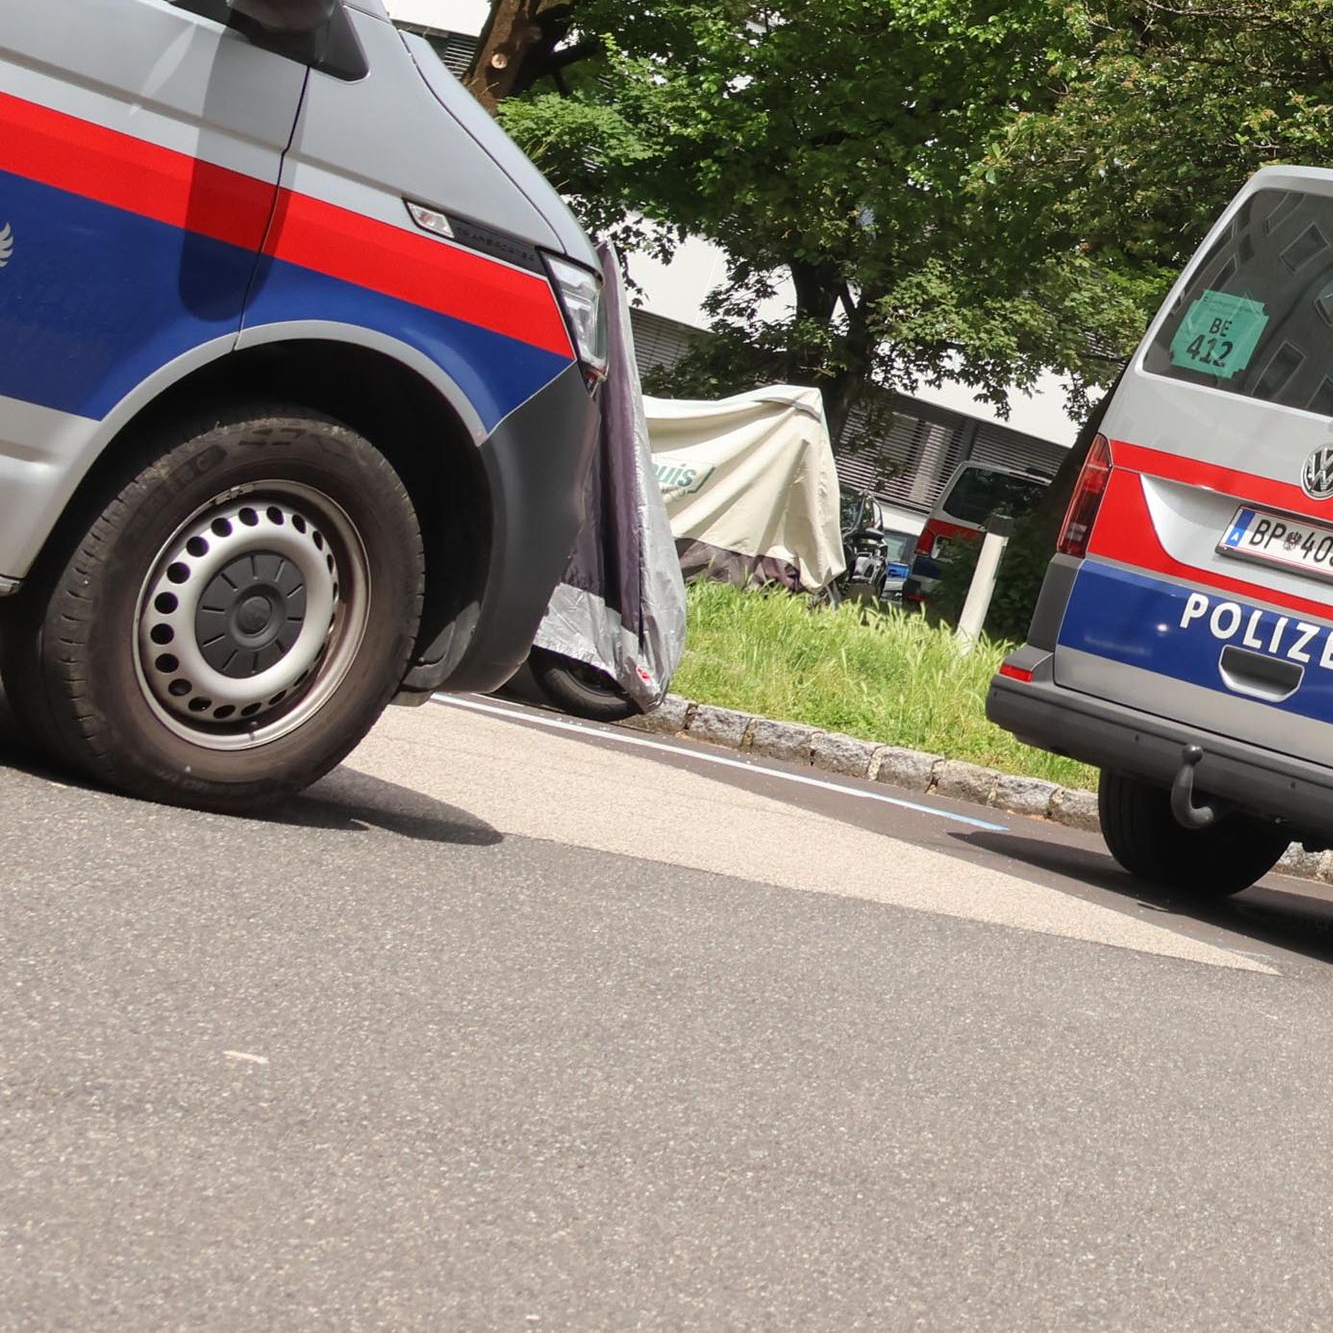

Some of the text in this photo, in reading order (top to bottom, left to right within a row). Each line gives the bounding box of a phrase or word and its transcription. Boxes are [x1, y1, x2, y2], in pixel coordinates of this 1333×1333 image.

[1209, 317, 1233, 337] BE
[1186, 334, 1234, 367] 412
[1249, 519, 1287, 550] BP
